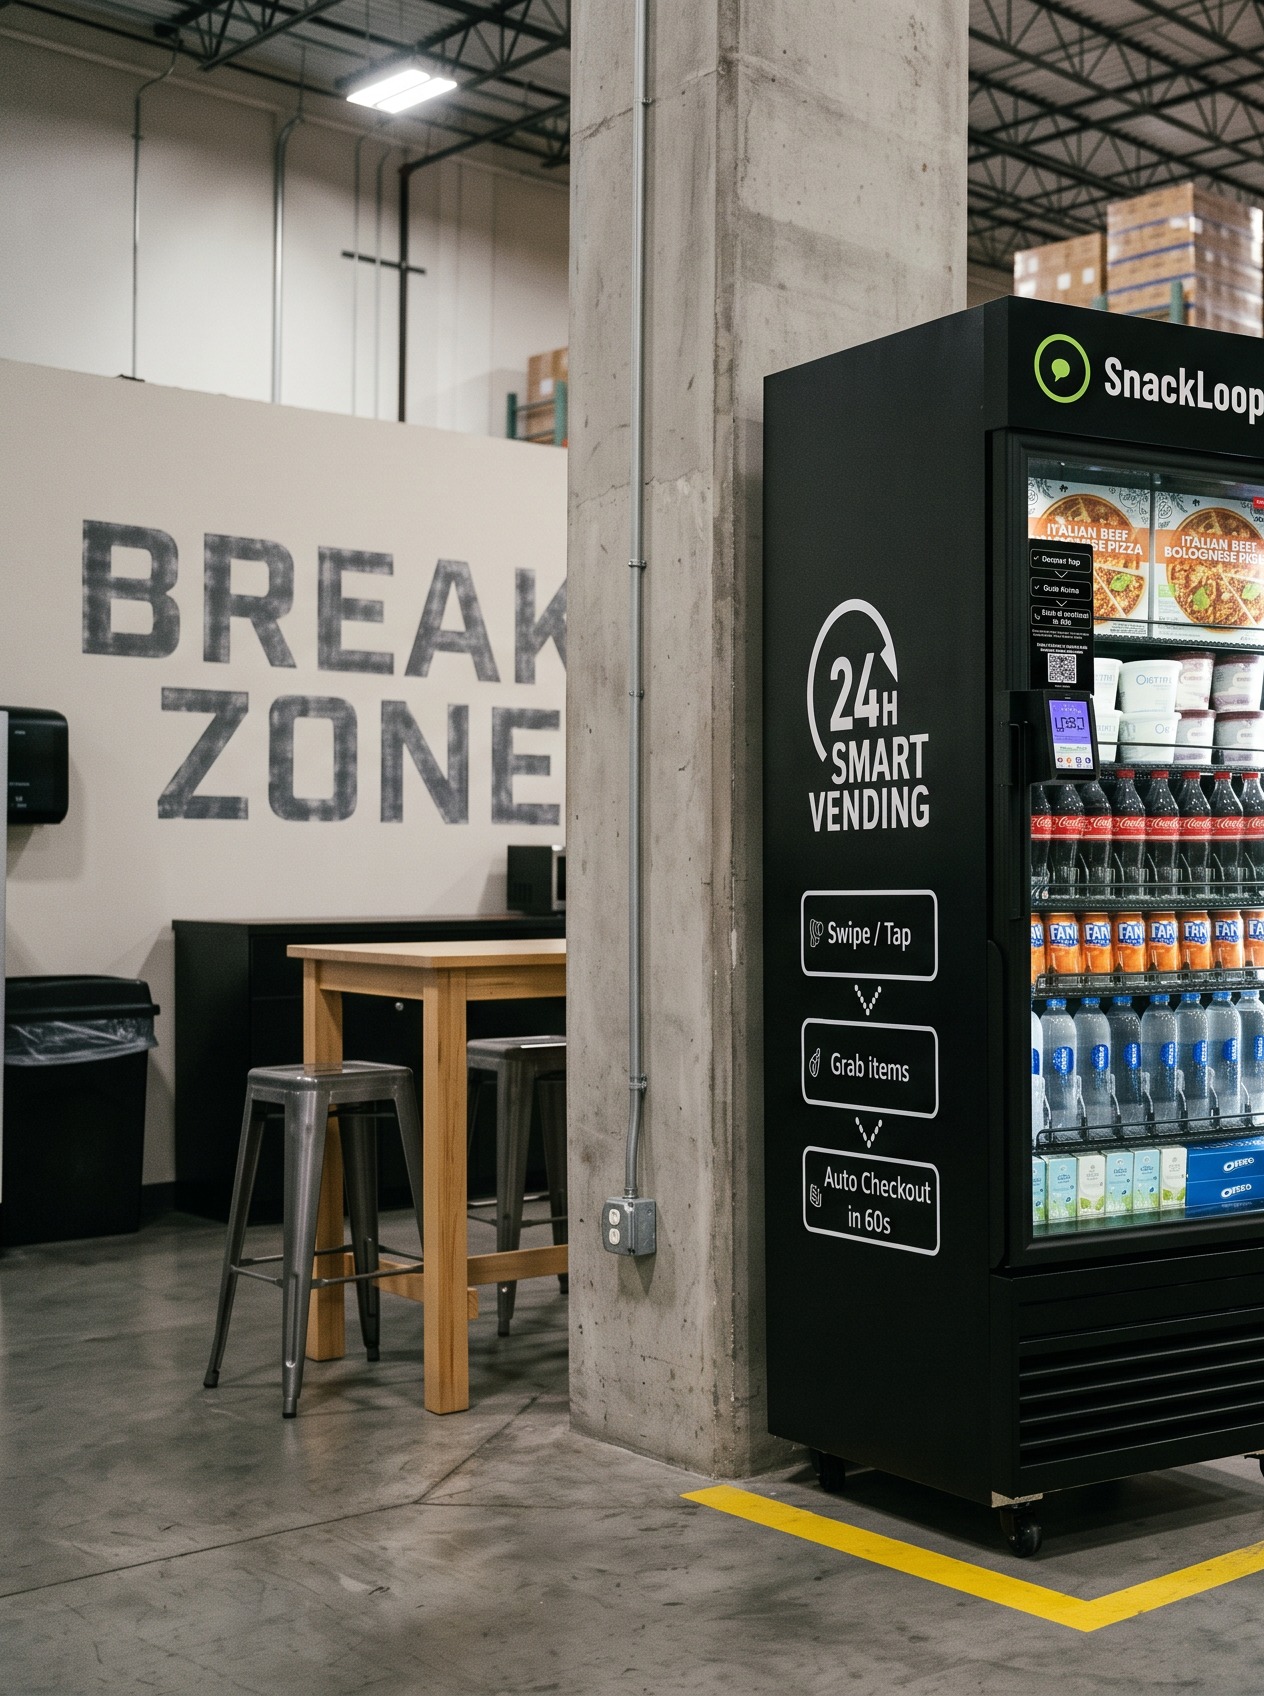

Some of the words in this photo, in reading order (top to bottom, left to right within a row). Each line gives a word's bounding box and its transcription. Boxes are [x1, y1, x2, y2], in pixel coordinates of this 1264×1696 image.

[1104, 357, 1264, 425] SnackLoop
[1047, 523, 1097, 539] ITALIAN
[1101, 528, 1128, 541] BEEF
[1181, 535, 1228, 550] ITALIAN
[1108, 541, 1143, 555] PIZZA
[1164, 546, 1236, 563] BOLOGNESE
[82, 519, 568, 684] BREAK
[157, 686, 561, 826] ZONE
[831, 733, 929, 785] SMART
[808, 784, 930, 832] VENDING
[827, 920, 871, 950] Swipe
[884, 922, 912, 951] Tap
[830, 1052, 865, 1078] Grab
[868, 1056, 910, 1082] items
[824, 1166, 858, 1192] Auto
[861, 1171, 932, 1204] Checkout
[848, 1205, 861, 1229] in
[865, 1208, 891, 1235] 60s
